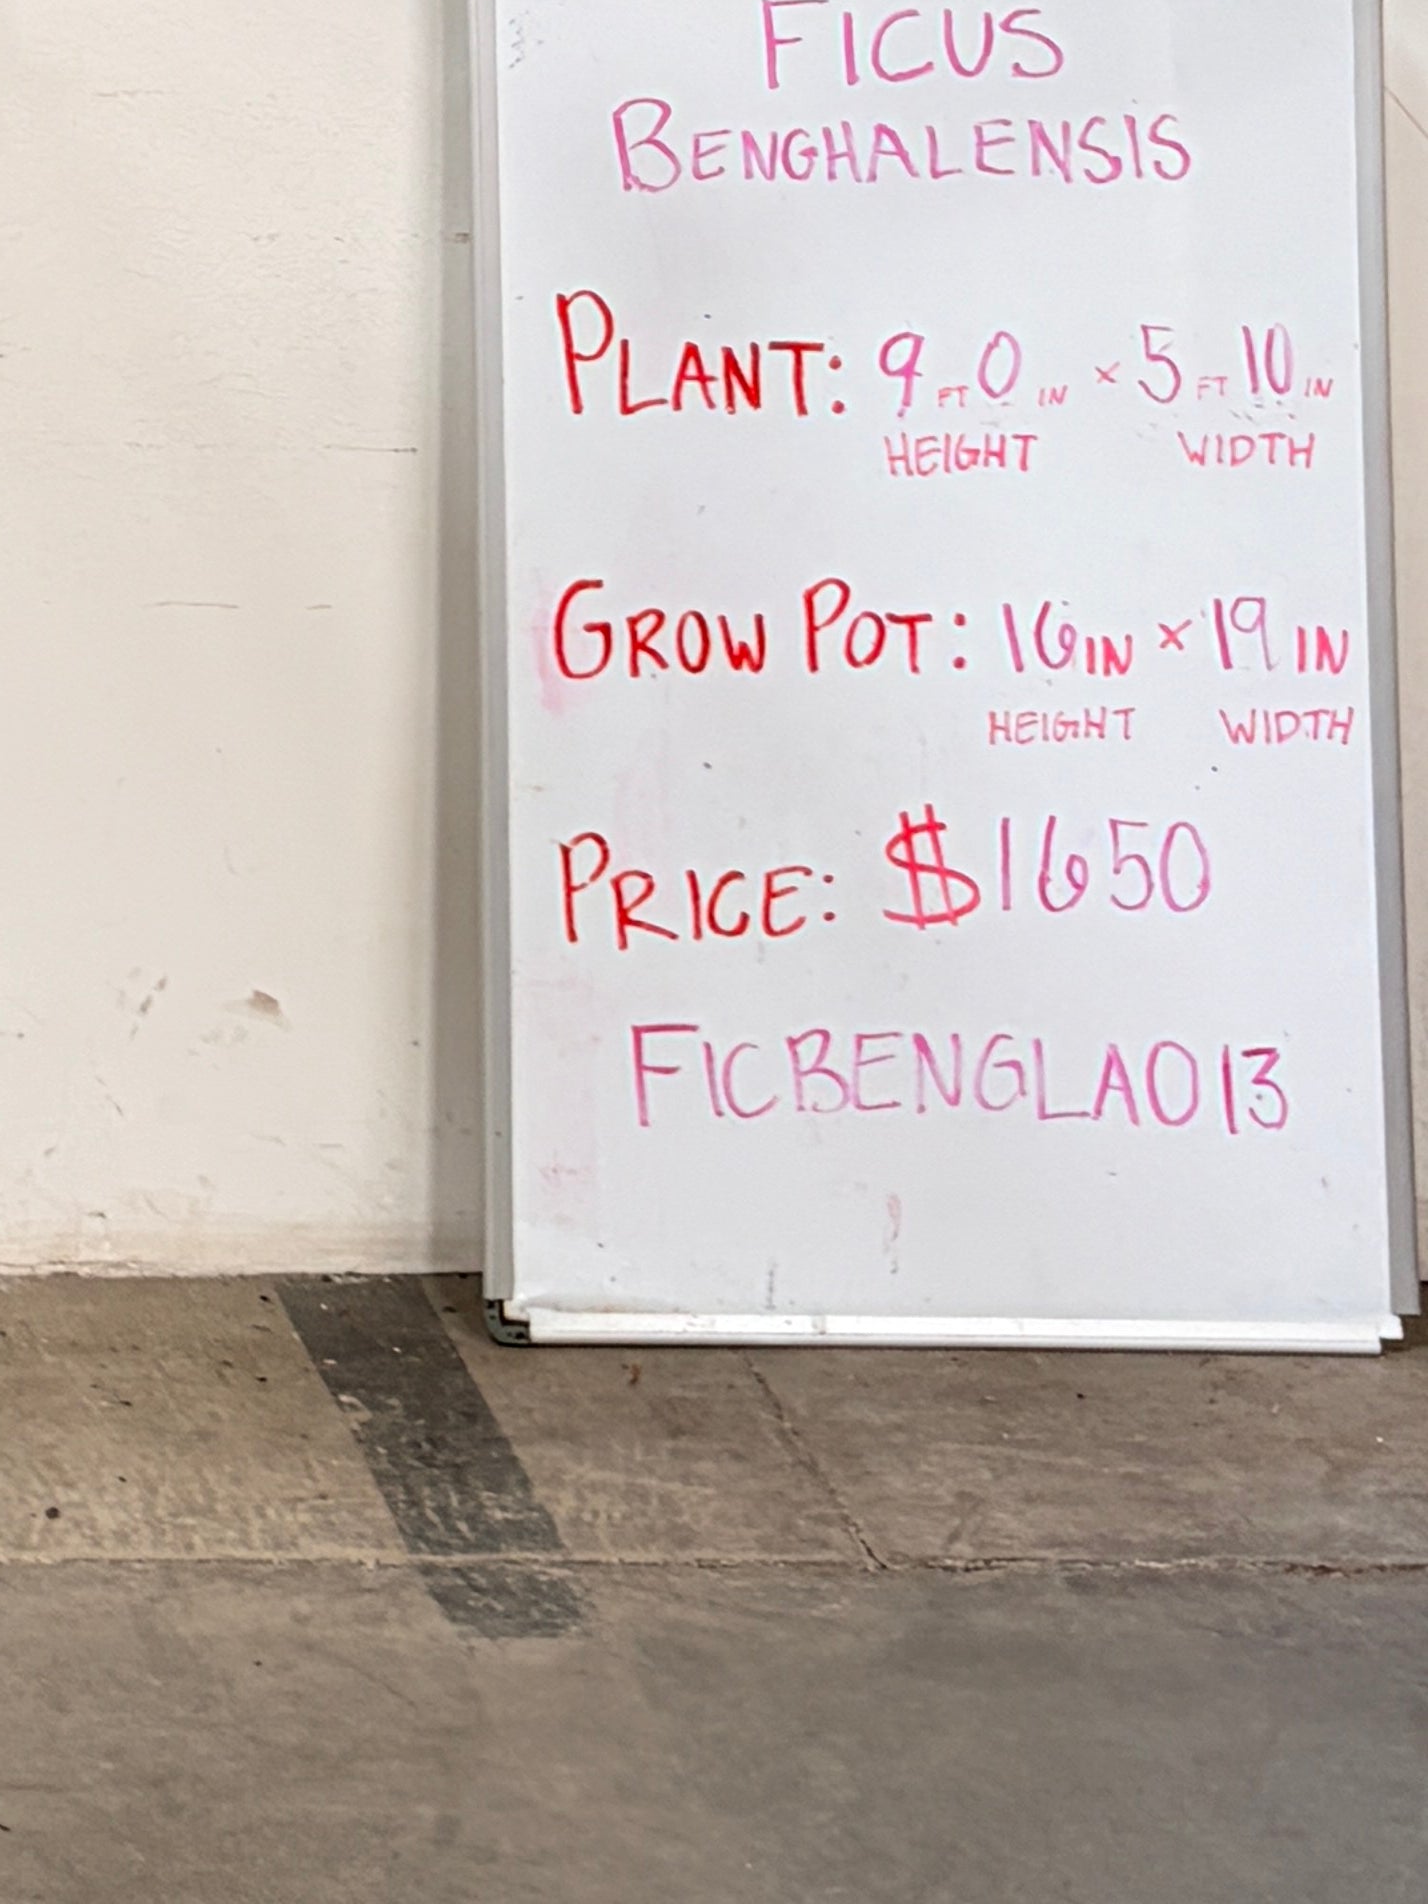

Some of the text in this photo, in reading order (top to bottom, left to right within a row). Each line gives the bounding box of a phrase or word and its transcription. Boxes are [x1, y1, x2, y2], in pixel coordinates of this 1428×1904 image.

[612, 97, 1192, 192] BENGHALENSIS
[555, 290, 846, 418] PLANT:
[878, 331, 925, 418] 9
[937, 383, 968, 409] FT
[977, 330, 1021, 400] 0
[1037, 385, 1068, 408] IN
[1140, 324, 1183, 404] 5
[1197, 375, 1228, 400] FT
[1242, 324, 1293, 396] 10
[884, 431, 1316, 478] HEIGHT WIDTH
[554, 578, 767, 680] GROW
[802, 577, 967, 675] POT:
[1213, 595, 1278, 674] 19
[1297, 625, 1350, 676] IN
[987, 707, 1355, 747] HEIGHT WIDTH
[558, 803, 1212, 950] PRICE: $1650
[630, 1024, 1290, 1135] FICBENGLA013
